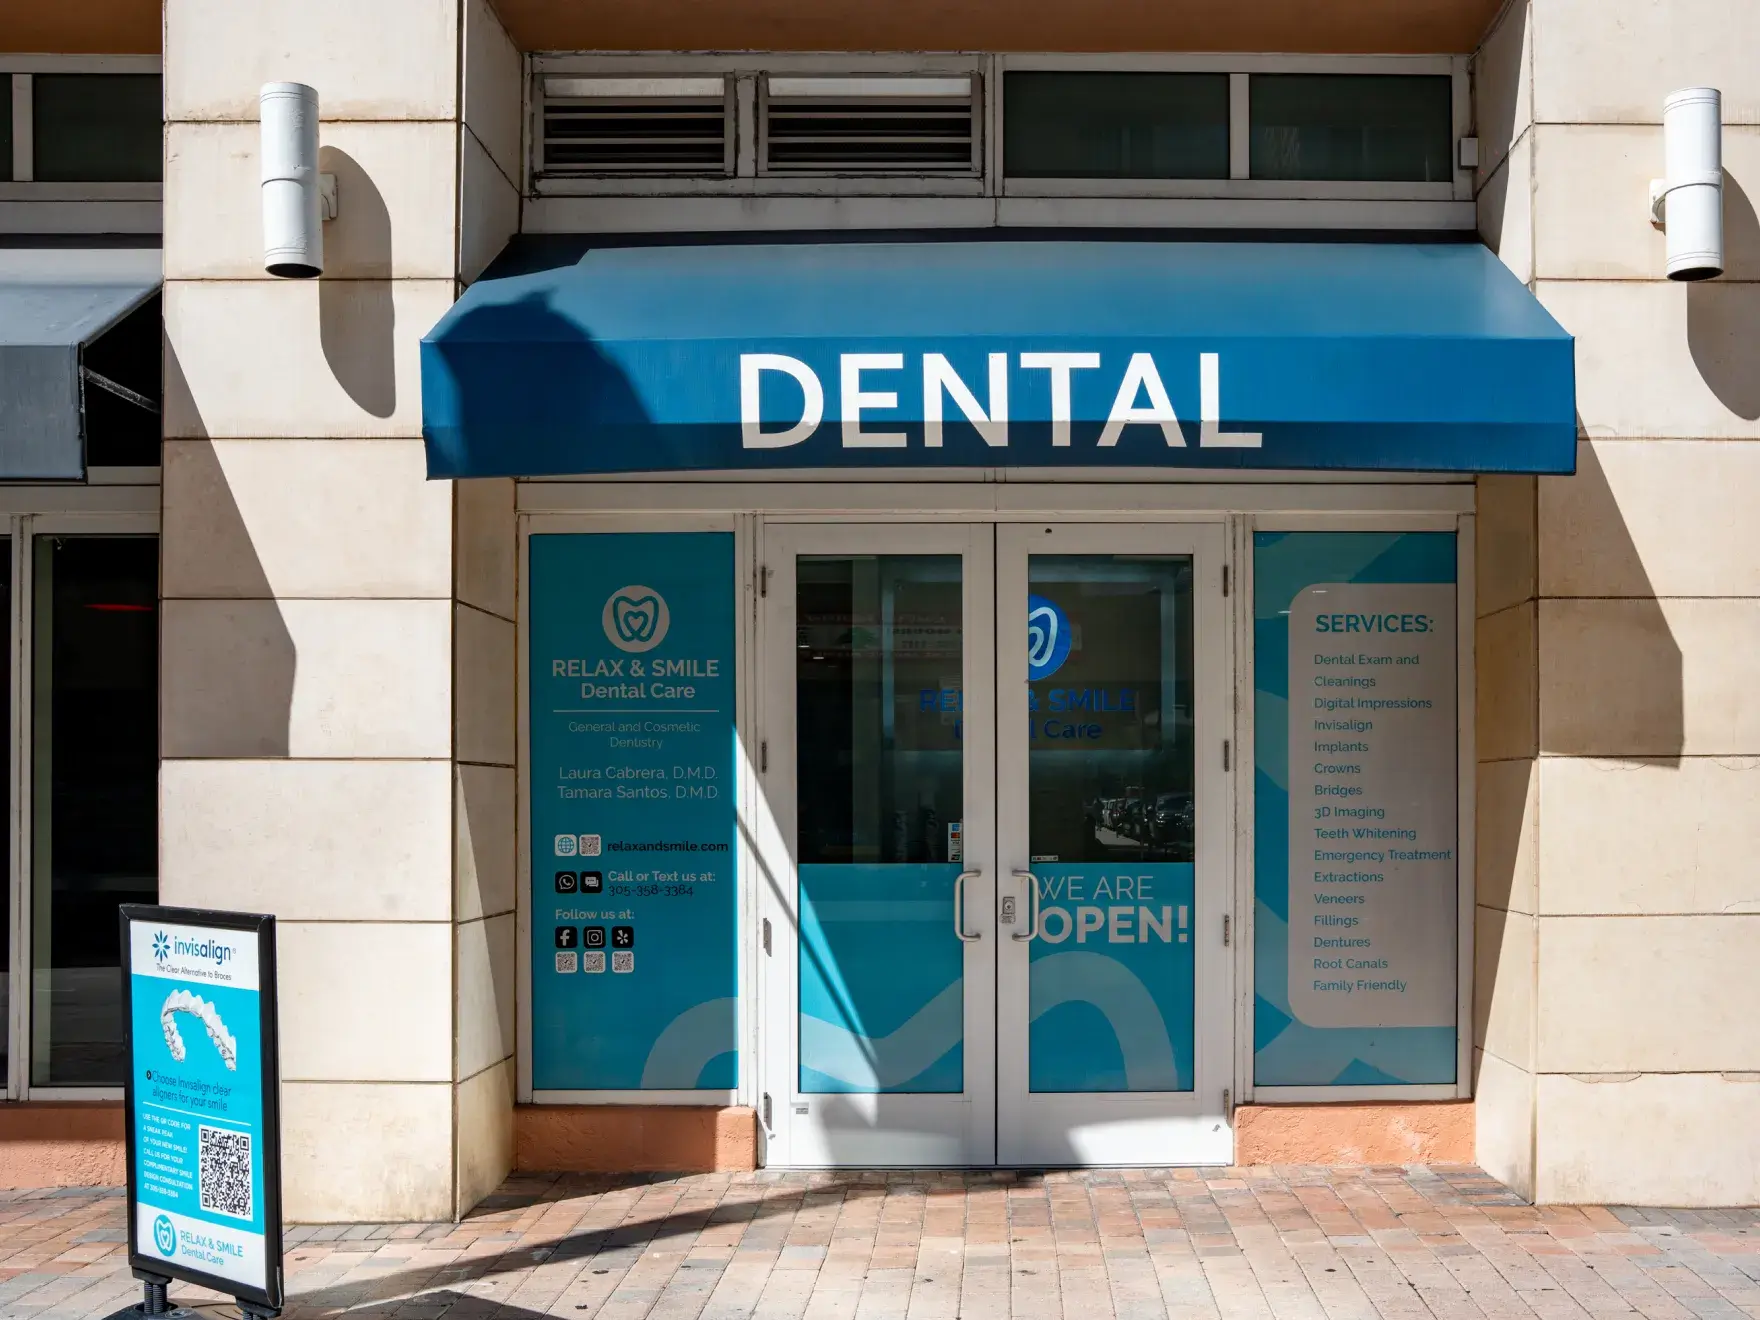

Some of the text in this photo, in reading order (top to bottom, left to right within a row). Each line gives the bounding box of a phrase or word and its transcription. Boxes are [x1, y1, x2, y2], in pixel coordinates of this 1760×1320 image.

[738, 351, 1262, 450] DENTAL
[1316, 614, 1433, 632] SERVICES:
[1314, 655, 1419, 665] Dental Exam and
[553, 660, 719, 677] RELAX & SMILE
[1314, 677, 1376, 689] Cleanings
[582, 683, 695, 698] Dental Care
[1049, 689, 1135, 712] SMILE
[1314, 698, 1432, 711] Digital Impressions
[569, 722, 700, 732] General and Cosmetic
[1044, 721, 1102, 739] Care
[1315, 720, 1372, 732] Invisalign
[610, 737, 663, 749] Dentistry
[1315, 742, 1368, 754] Implants
[560, 766, 718, 780] Laura Cabrera, D.M.D.
[1314, 764, 1360, 774] Crowns
[558, 786, 612, 798] Tamara
[616, 786, 670, 800] Santos,
[1315, 785, 1362, 797] Bridges
[1314, 807, 1384, 819] 3D Imaging
[1314, 829, 1416, 841] Teeth Whitening
[608, 841, 728, 851] relaxandsmile.com
[1314, 850, 1451, 863] Emergency Treatment
[608, 871, 716, 881] Call or Text us at:
[1314, 872, 1384, 882] Extractions
[608, 885, 693, 896] 305-358-3384
[1039, 876, 1153, 900] WE ARE
[1314, 894, 1365, 904] Veneers
[556, 909, 597, 919] Follow
[619, 910, 634, 919] at:
[1038, 906, 1188, 943] OPEN!
[1314, 915, 1358, 928] Fillings
[1314, 938, 1370, 947] Dentures
[174, 936, 231, 965] invisalign
[1314, 958, 1388, 969] Root Canals
[156, 963, 165, 972] The
[166, 965, 179, 974] Clear
[180, 966, 206, 978] Alternative
[214, 971, 232, 980] Braces
[1314, 980, 1406, 992] Family Friendly
[152, 1070, 232, 1096] Choose Invisalign clear
[152, 1086, 228, 1111] aligners for your smile
[180, 1230, 243, 1257] RELAX & SMILE
[182, 1245, 224, 1265] Dental Care
